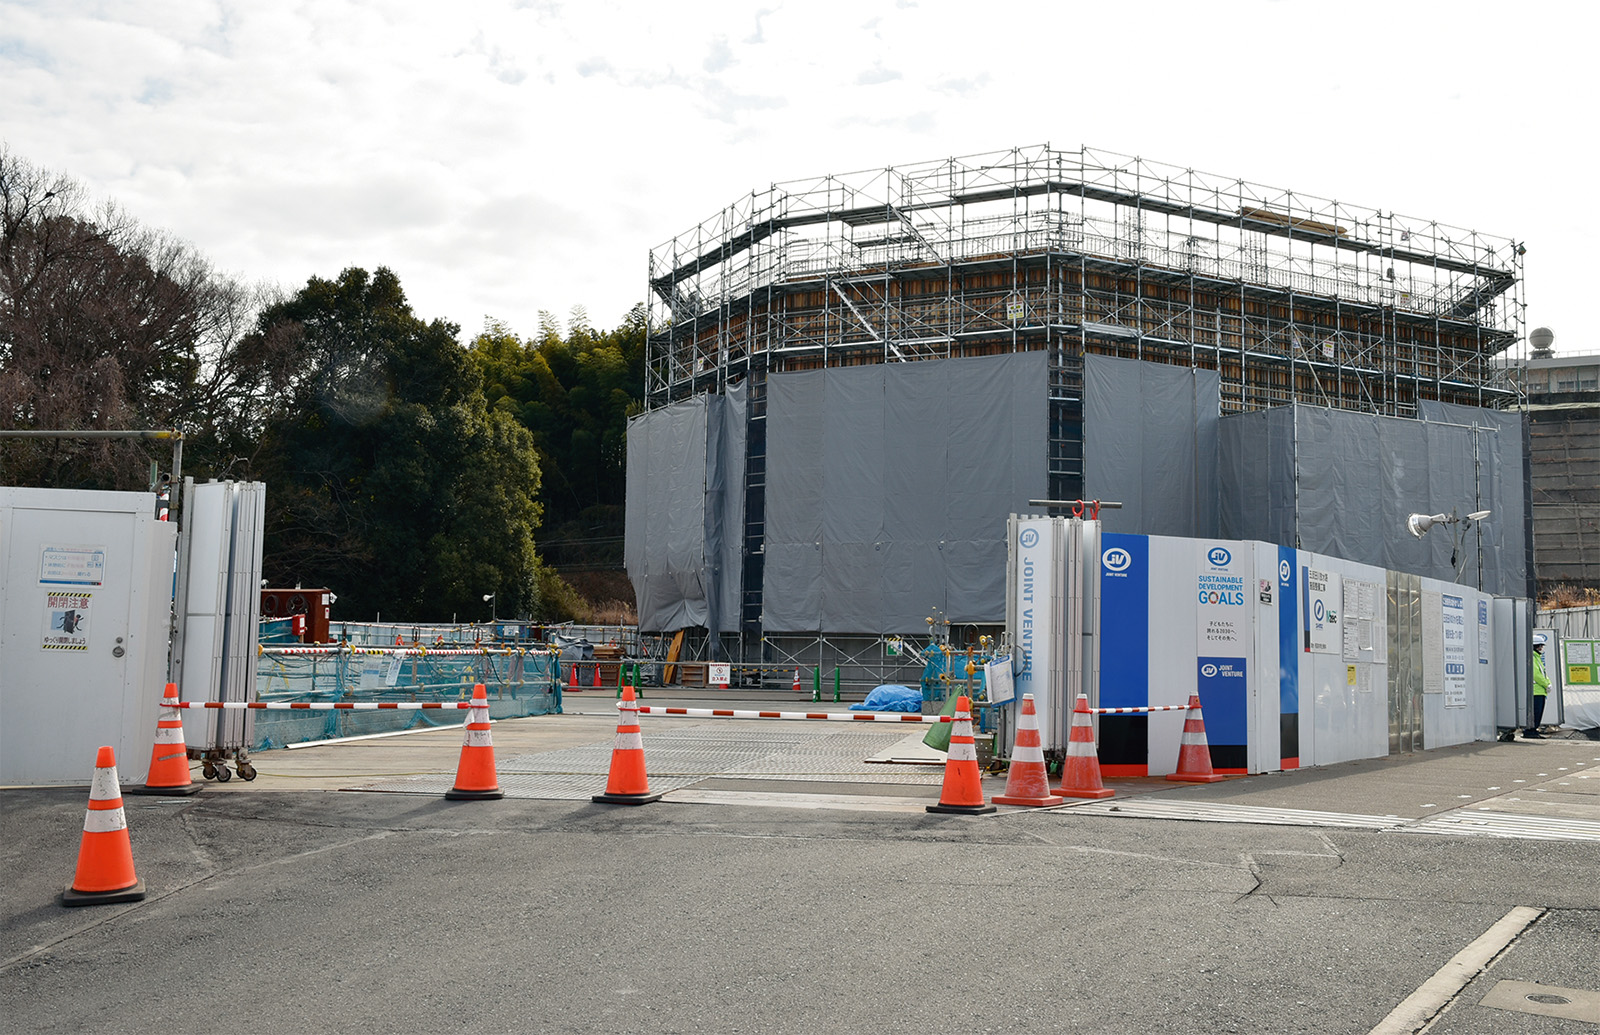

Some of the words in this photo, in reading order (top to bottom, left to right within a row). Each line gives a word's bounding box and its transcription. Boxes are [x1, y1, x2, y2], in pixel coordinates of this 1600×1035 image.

[1023, 557, 1034, 603] JOINT
[1198, 575, 1243, 584] SUSTAINABLE
[1198, 583, 1243, 591] DEVELOPMENT
[48, 596, 89, 609] 開閉注意
[1198, 590, 1244, 606] GOALS
[1022, 608, 1033, 682] VENTURE
